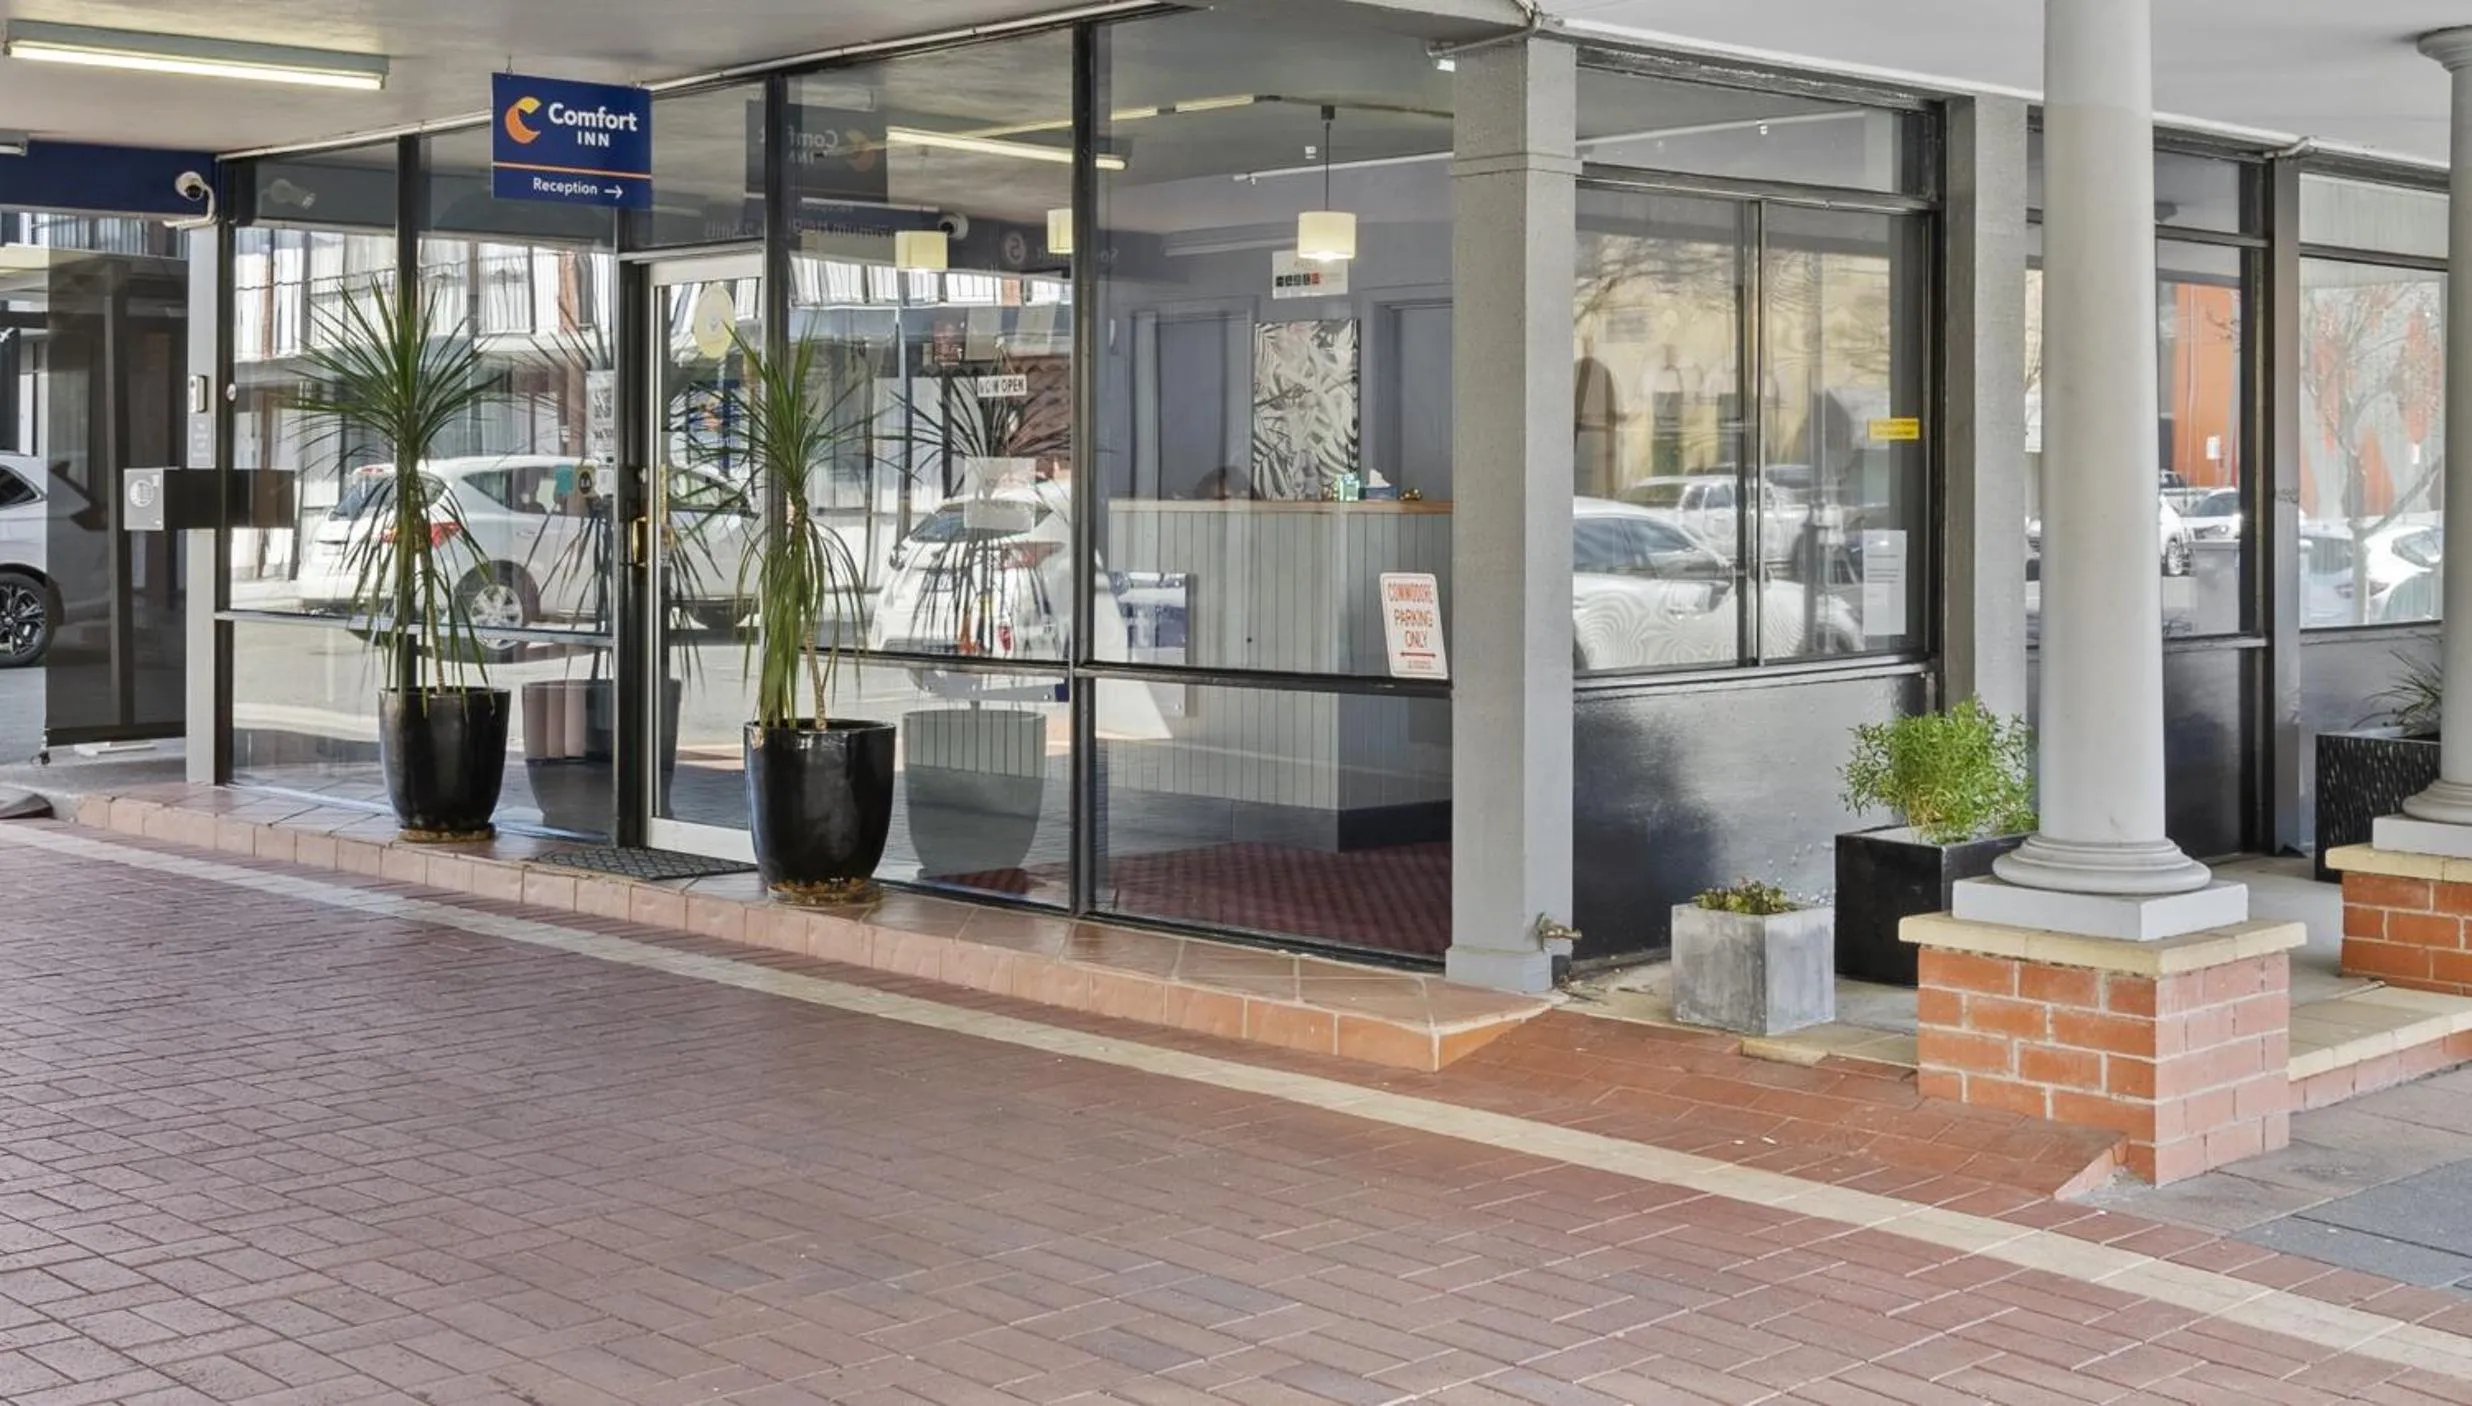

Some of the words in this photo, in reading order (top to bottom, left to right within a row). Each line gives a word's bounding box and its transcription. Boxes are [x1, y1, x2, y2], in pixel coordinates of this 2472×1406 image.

[548, 102, 638, 131] Comfort
[577, 131, 610, 147] INN
[533, 177, 598, 196] Reception
[979, 380, 999, 394] NOW
[1001, 378, 1025, 392] OPEN
[1394, 609, 1433, 628] PARKING
[1405, 630, 1428, 648] ONLY
